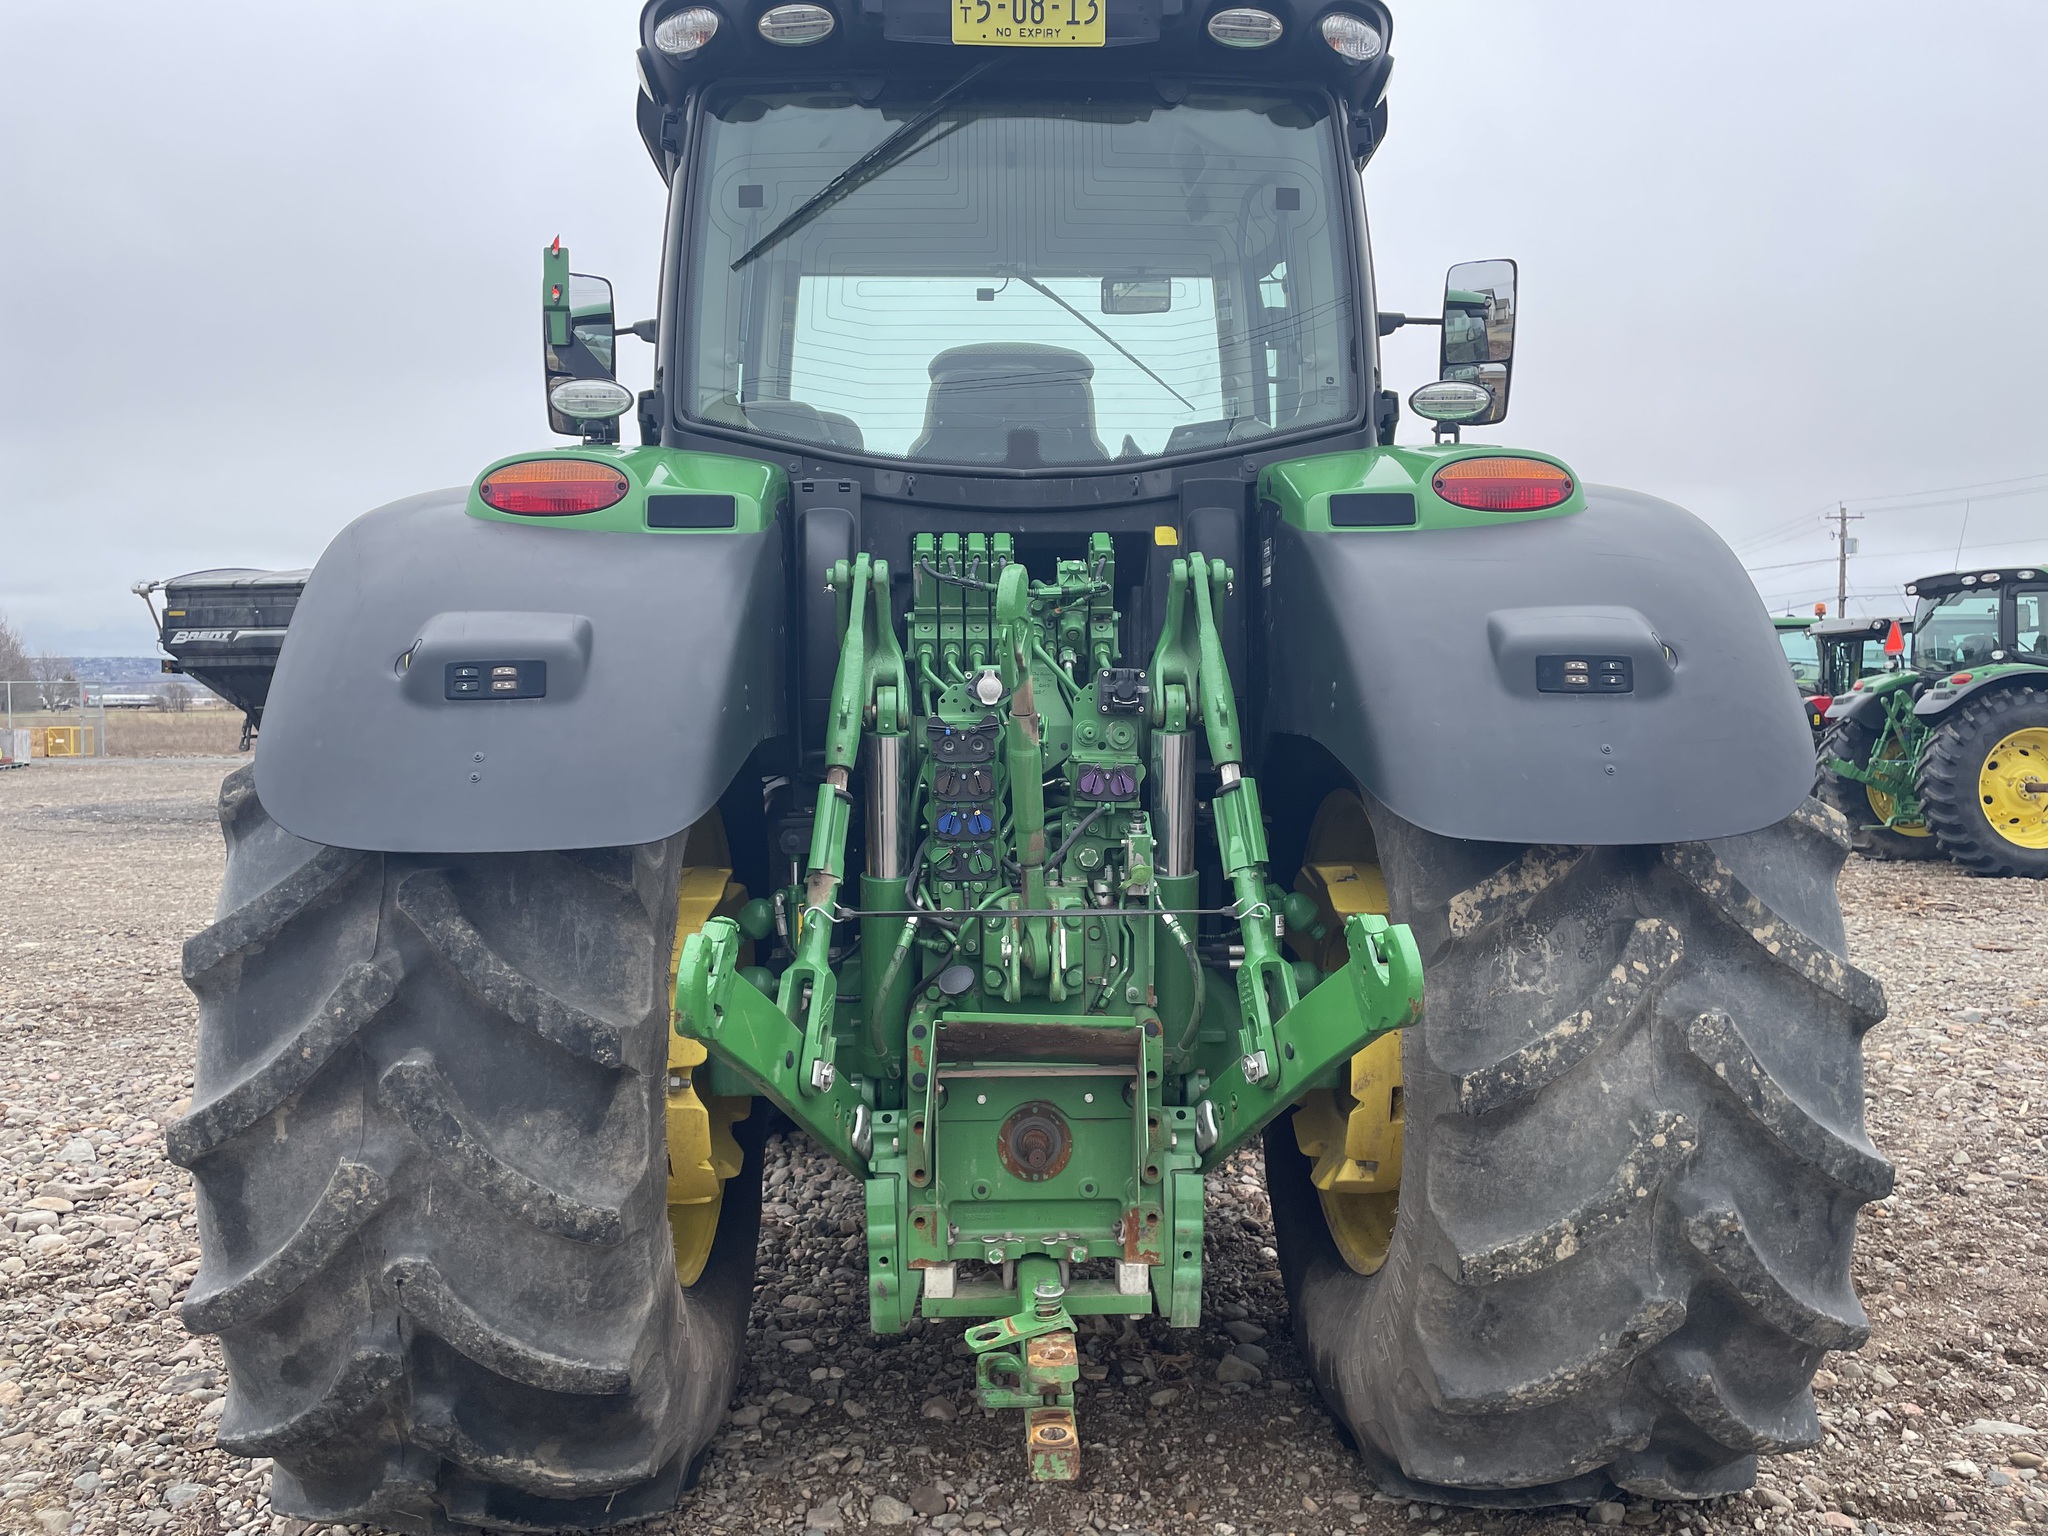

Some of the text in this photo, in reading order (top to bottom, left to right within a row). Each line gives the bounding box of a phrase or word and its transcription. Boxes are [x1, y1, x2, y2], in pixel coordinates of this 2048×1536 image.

[996, 27, 1061, 38] NO EXPIRY
[171, 630, 233, 644] BRENT
